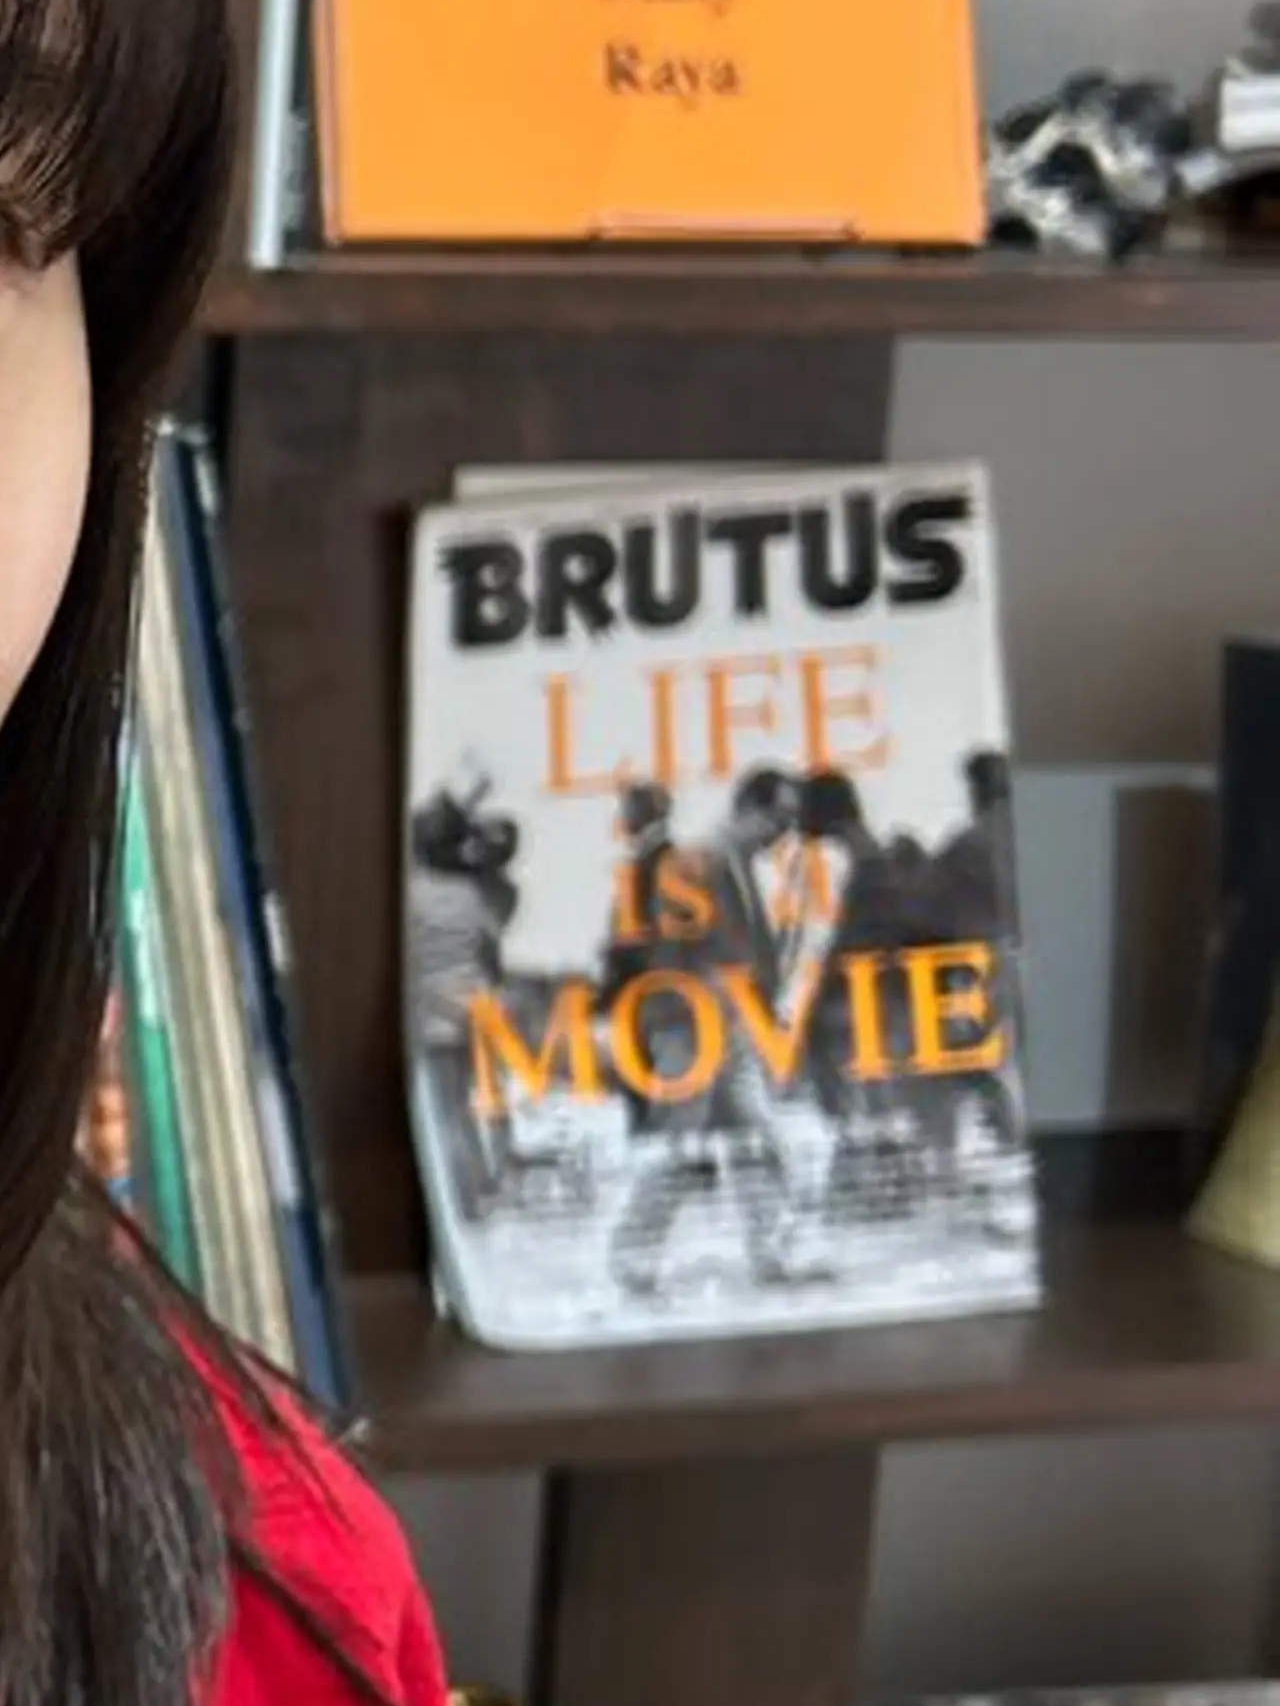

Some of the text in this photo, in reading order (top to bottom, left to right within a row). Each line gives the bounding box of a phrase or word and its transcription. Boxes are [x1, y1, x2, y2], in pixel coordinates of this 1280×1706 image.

[606, 41, 740, 106] Raya
[442, 494, 972, 650] BRUTUS
[541, 643, 895, 798] LIFE
[468, 941, 1008, 1123] MOVIE
